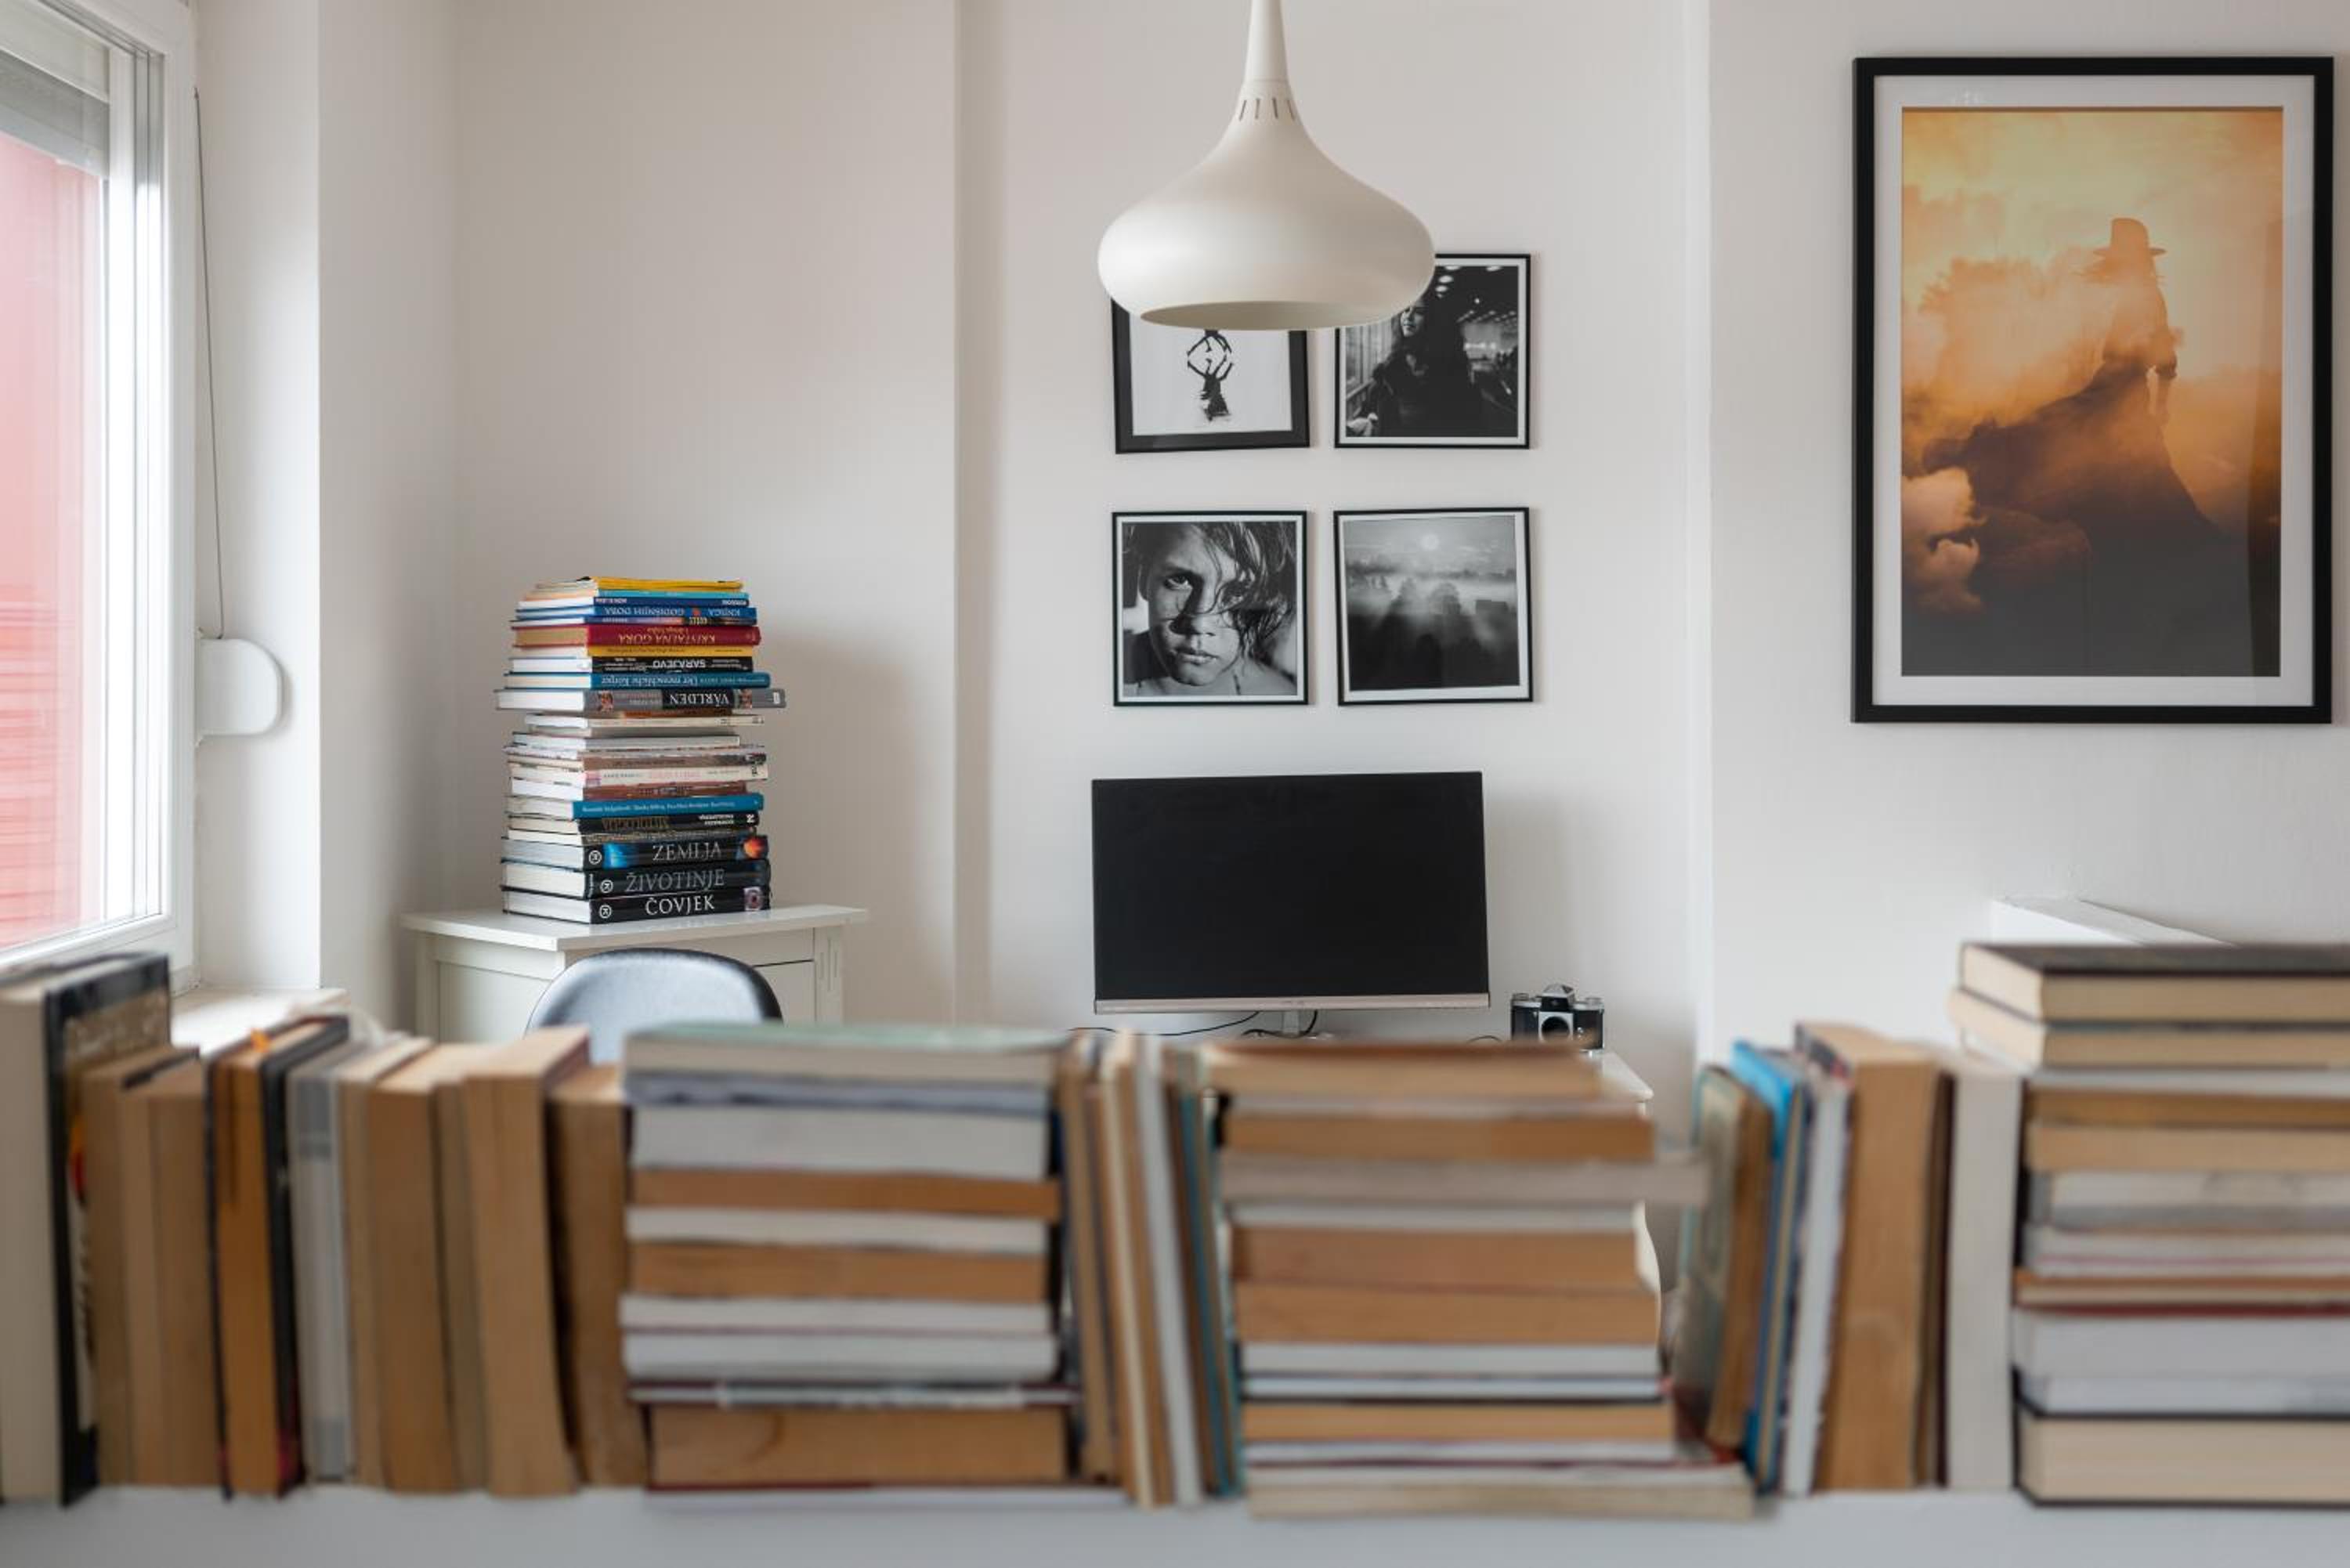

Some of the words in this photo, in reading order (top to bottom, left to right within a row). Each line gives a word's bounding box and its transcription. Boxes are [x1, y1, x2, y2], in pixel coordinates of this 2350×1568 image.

[707, 606, 741, 616] KNJIGA
[618, 633, 653, 643] GORA
[653, 659, 706, 669] SARAJEVO
[652, 841, 721, 862] ZEMLJA
[625, 869, 725, 892] ŽIVOTINJE
[645, 895, 715, 916] ČOVJEK
